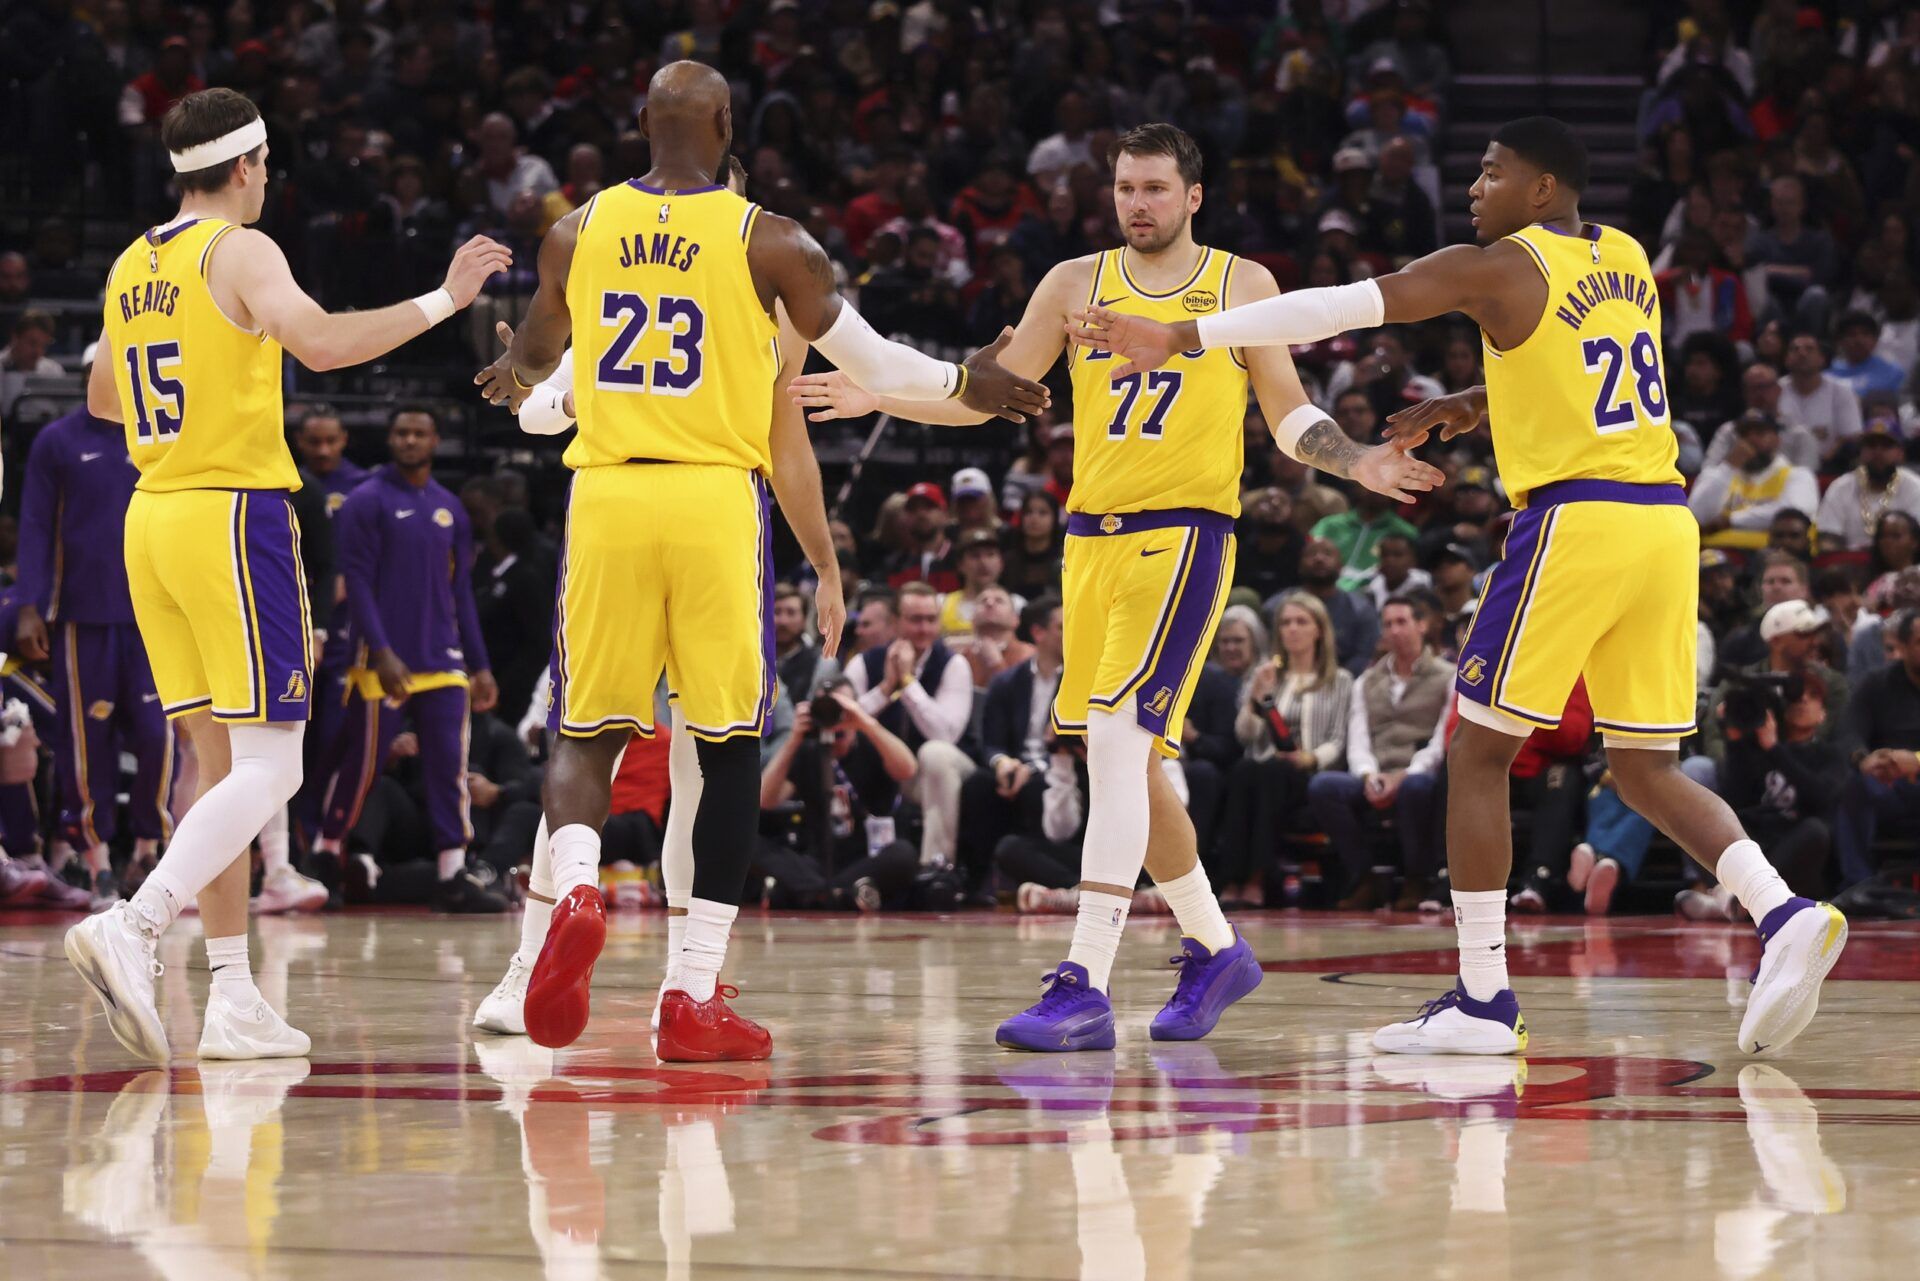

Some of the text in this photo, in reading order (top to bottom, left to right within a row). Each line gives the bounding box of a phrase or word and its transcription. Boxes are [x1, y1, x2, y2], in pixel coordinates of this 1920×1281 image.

[619, 233, 700, 272] JAMES
[120, 280, 180, 323] REAVES
[1185, 296, 1215, 306] bibigo
[1556, 271, 1657, 330] HACHIMURA
[595, 290, 706, 397] 23
[126, 339, 185, 445] 15
[1107, 370, 1184, 440] 77
[1581, 329, 1671, 435] 28
